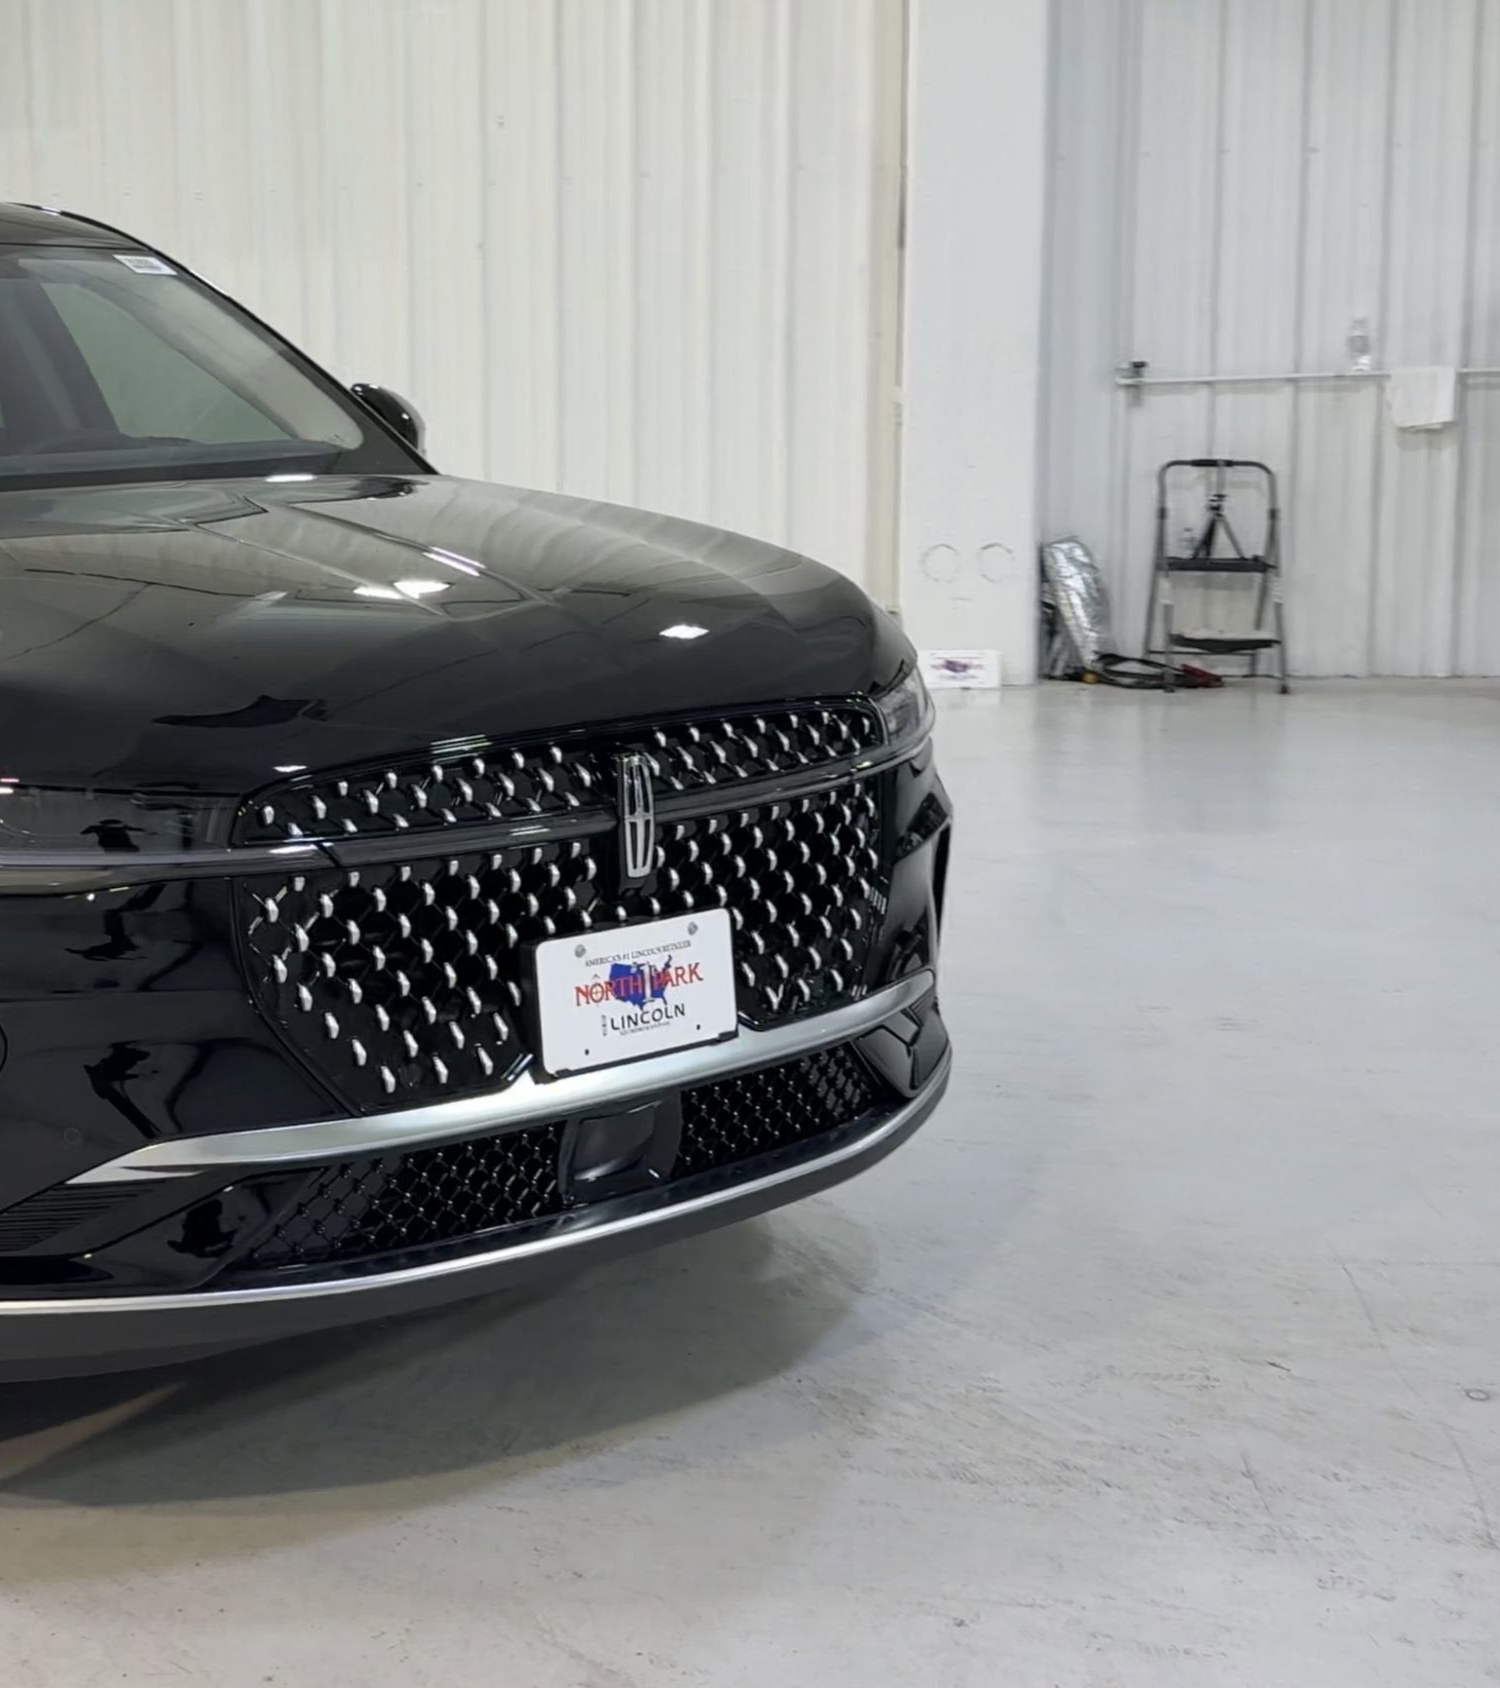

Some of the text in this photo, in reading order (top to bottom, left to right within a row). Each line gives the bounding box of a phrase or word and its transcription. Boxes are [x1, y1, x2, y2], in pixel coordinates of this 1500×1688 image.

[575, 962, 704, 1006] NORTH PARK
[611, 1003, 685, 1031] LINCOLN
